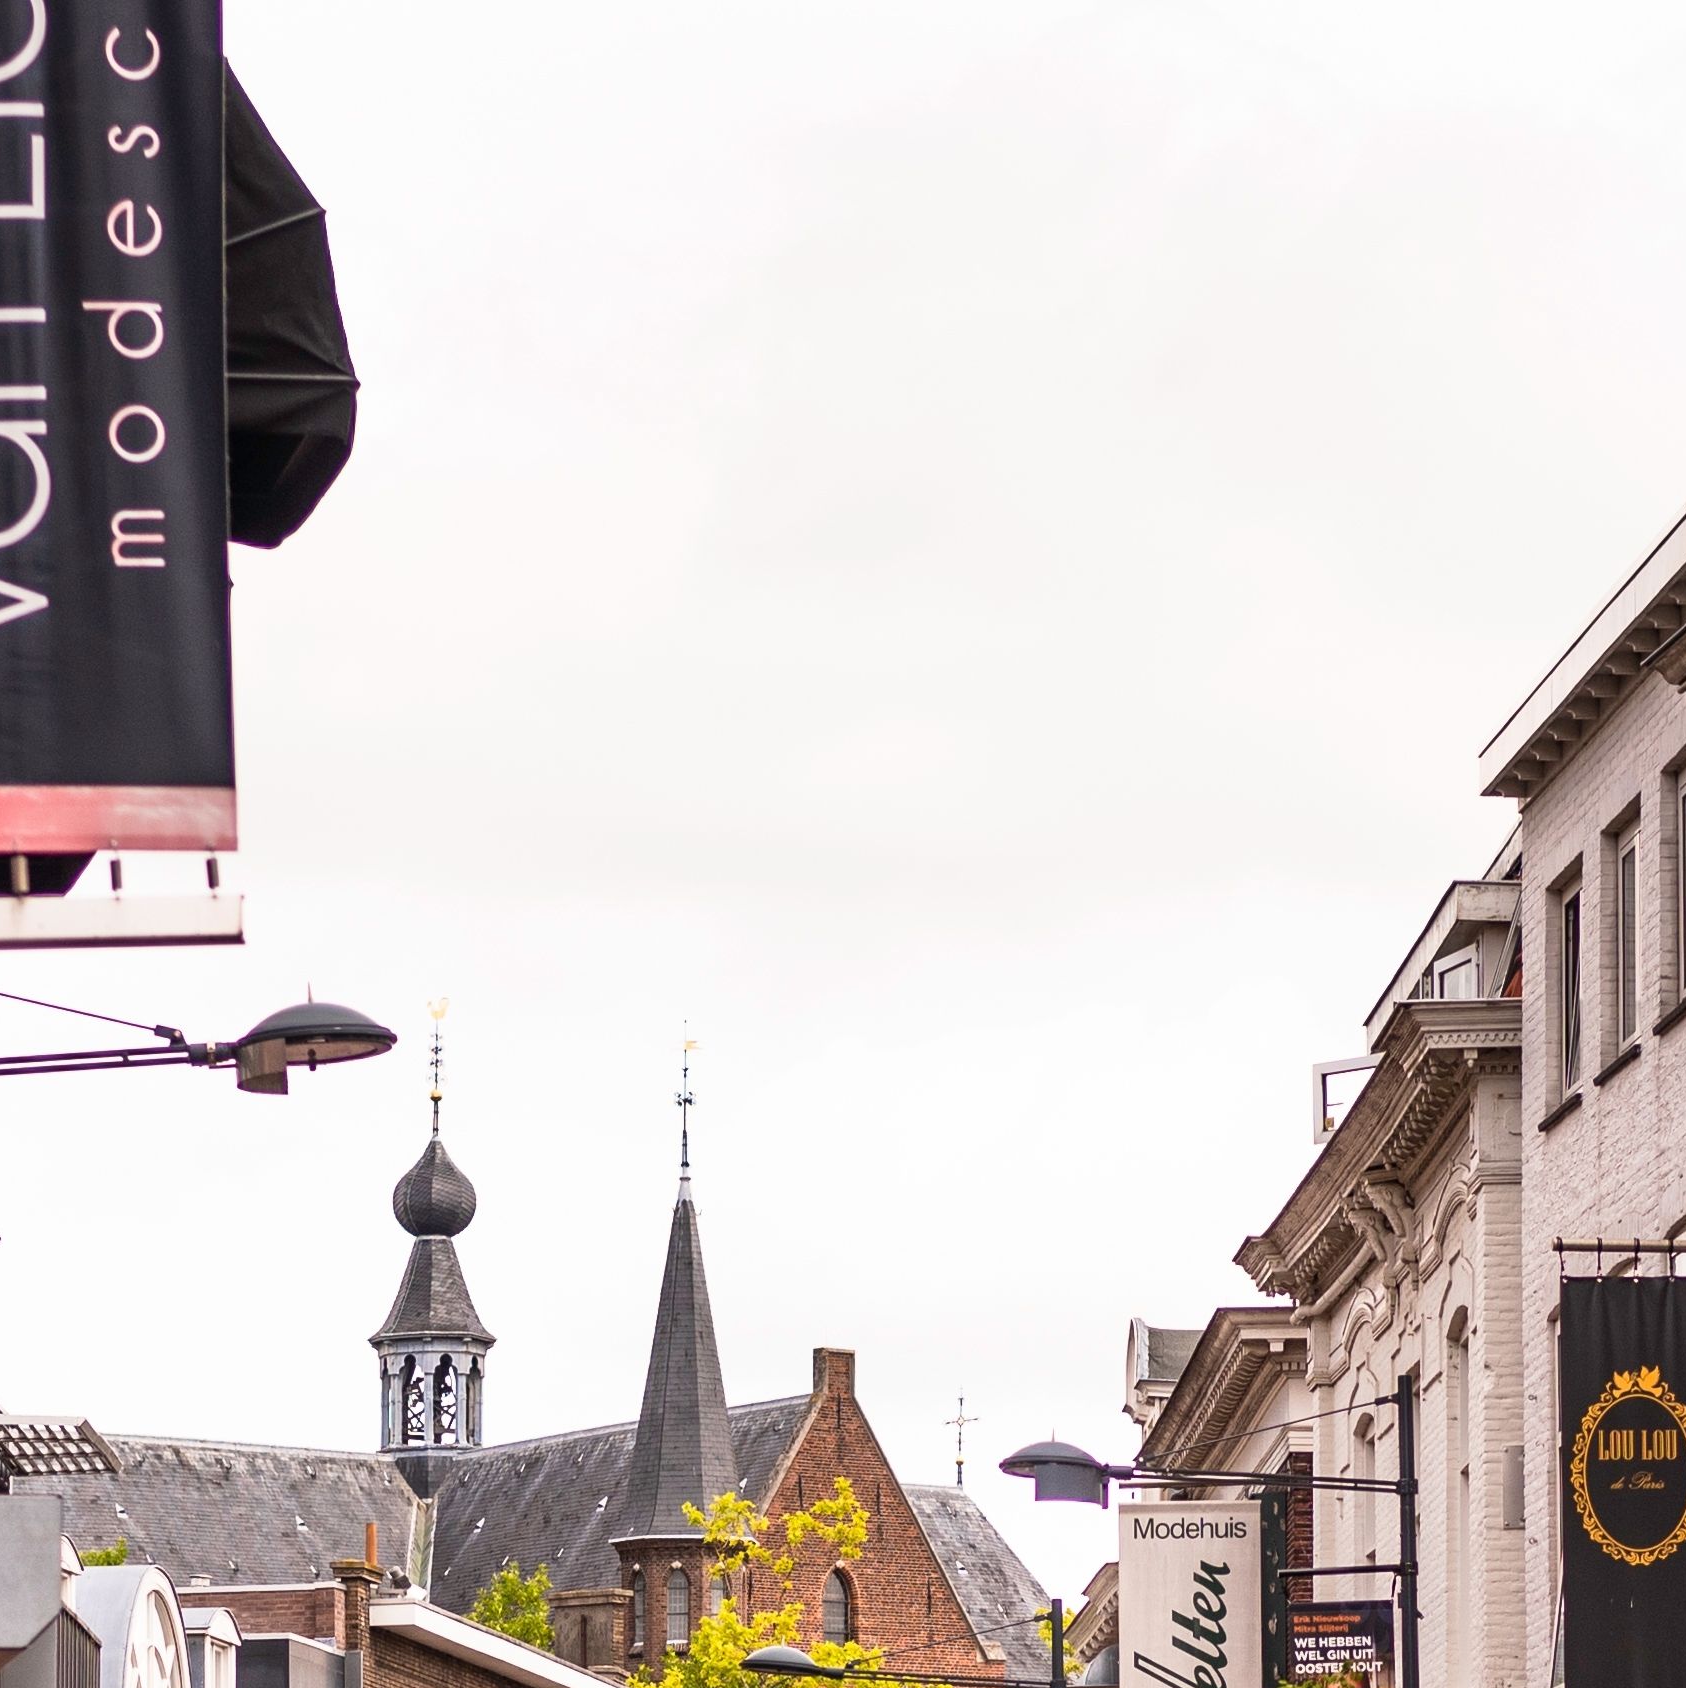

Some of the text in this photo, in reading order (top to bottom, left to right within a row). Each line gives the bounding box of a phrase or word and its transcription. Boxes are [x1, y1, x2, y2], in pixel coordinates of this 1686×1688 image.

[1598, 1429, 1677, 1460] LOU LOU
[1610, 1471, 1665, 1490] de Paris
[1133, 1517, 1247, 1540] Modehuis
[1294, 1635, 1371, 1648] WE HEBBEN
[1295, 1648, 1373, 1661] WEL GIN UIT
